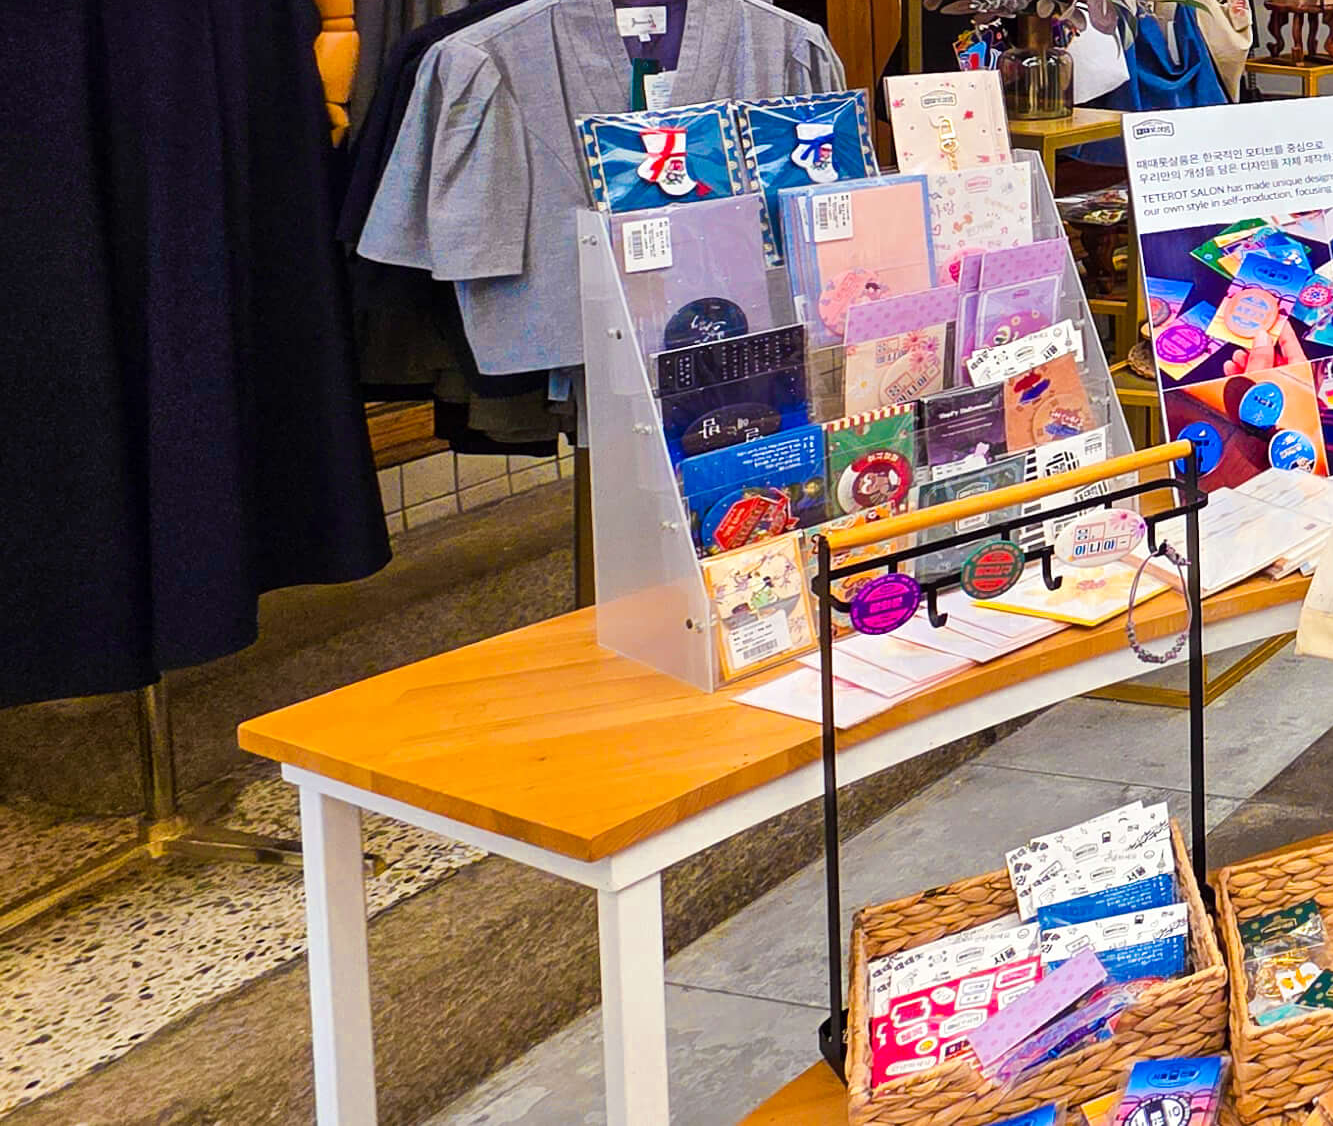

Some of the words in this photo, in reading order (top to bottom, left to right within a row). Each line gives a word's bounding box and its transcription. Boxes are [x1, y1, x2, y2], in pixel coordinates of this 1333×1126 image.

[1142, 190, 1187, 203] TETEROT
[1191, 185, 1225, 198] SALON
[1227, 184, 1243, 192] has
[1245, 180, 1270, 190] made
[1273, 177, 1302, 187] unique
[1163, 205, 1184, 214] own
[1187, 201, 1208, 211] style
[1211, 199, 1220, 207] in
[1295, 183, 1332, 196] focusing
